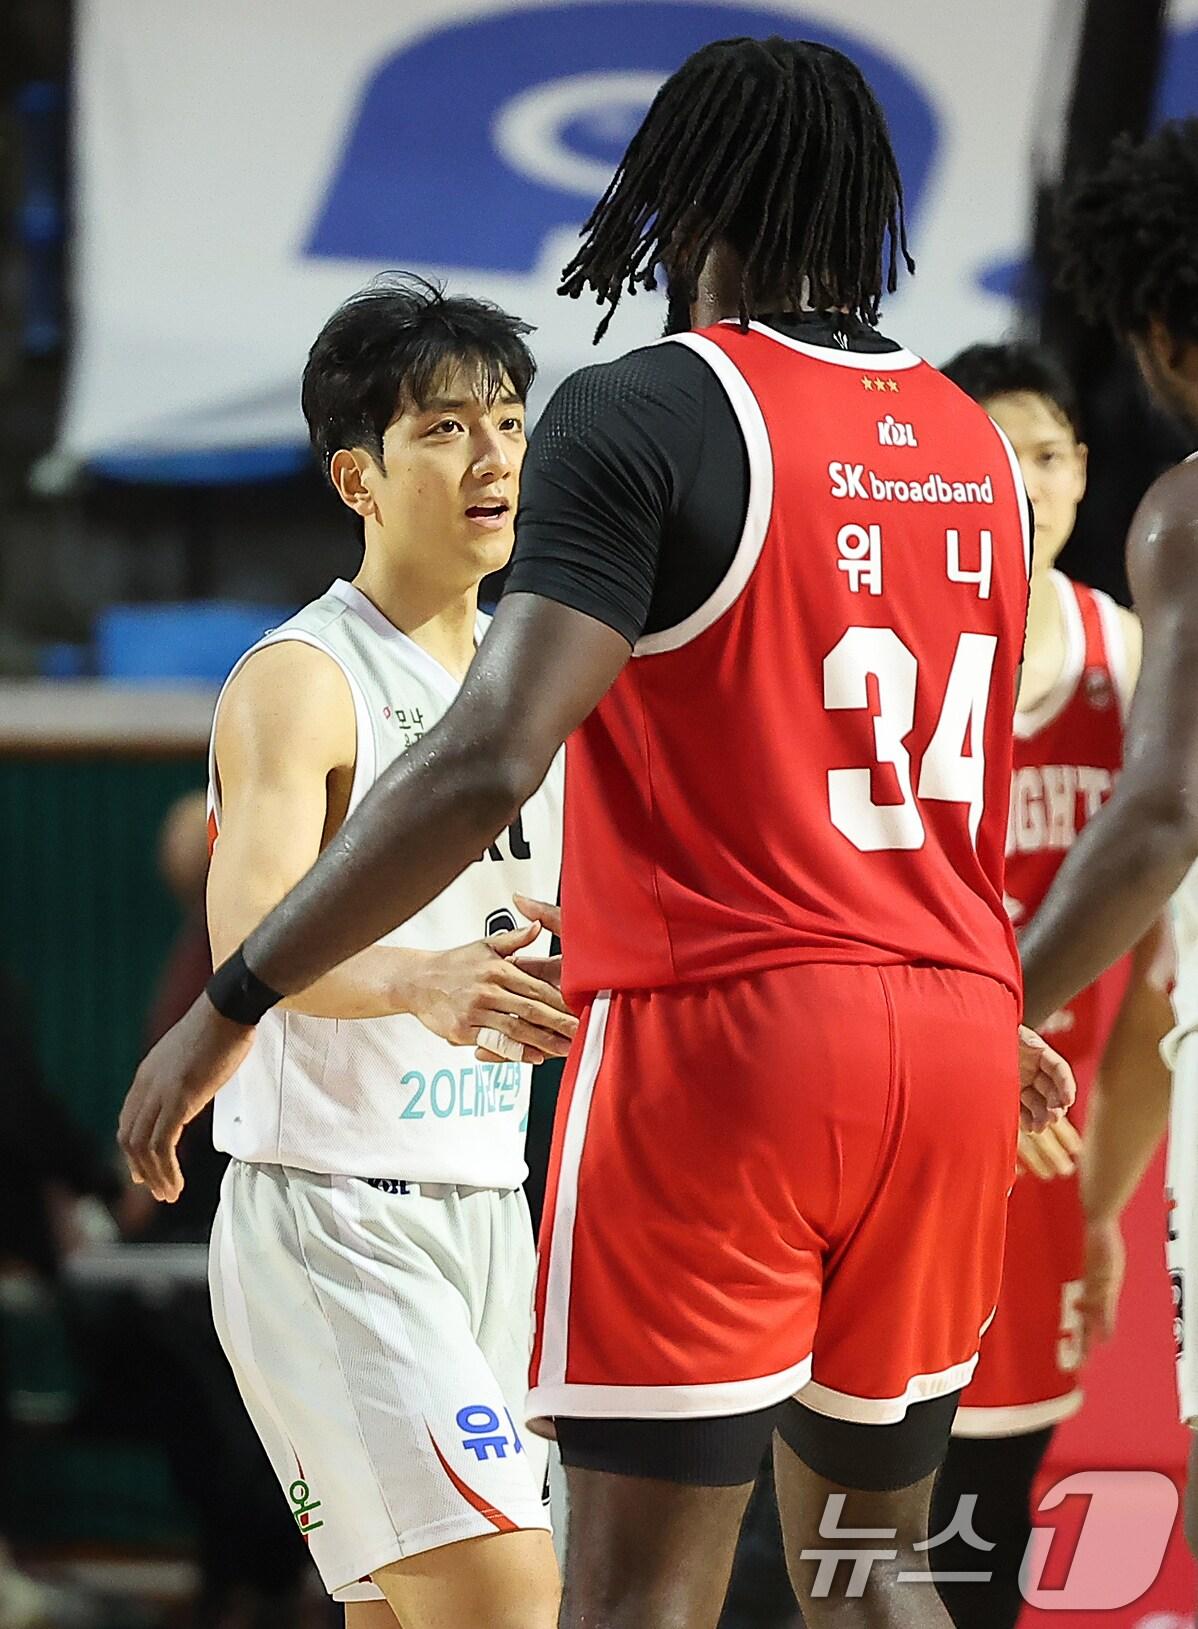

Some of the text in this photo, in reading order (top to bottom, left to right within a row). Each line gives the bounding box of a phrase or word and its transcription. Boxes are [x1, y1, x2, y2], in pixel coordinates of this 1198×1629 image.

[876, 414, 918, 447] KBL
[828, 461, 994, 504] SK broadband
[823, 626, 998, 853] 34
